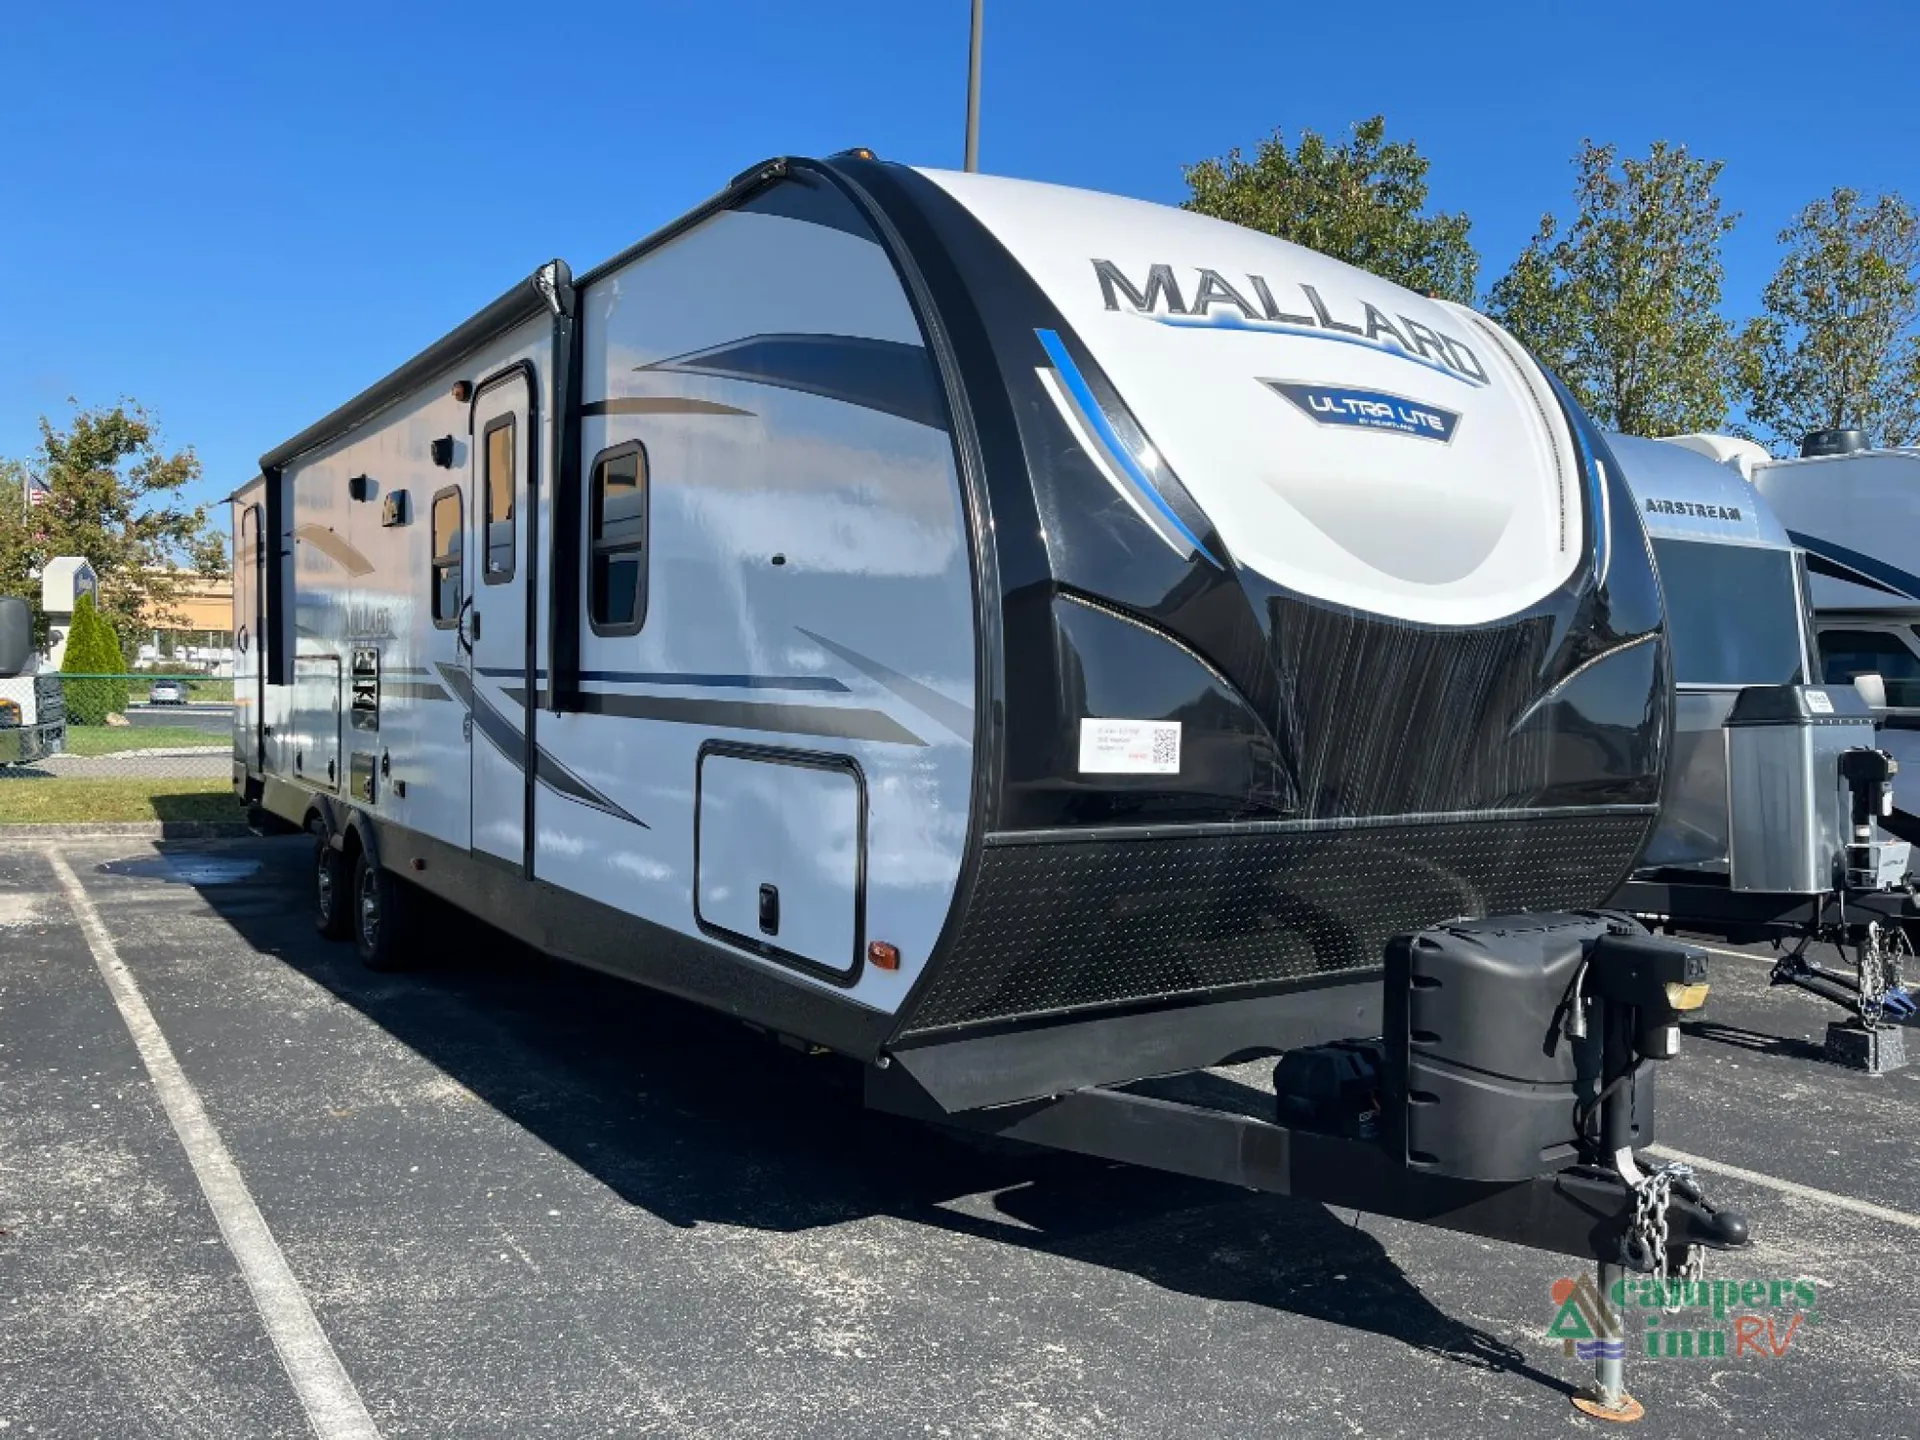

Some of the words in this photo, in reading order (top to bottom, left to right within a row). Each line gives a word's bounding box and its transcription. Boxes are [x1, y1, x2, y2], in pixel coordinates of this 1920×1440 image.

[1090, 258, 1491, 385] MALLARD
[1308, 396, 1394, 419] ULTRA
[1398, 406, 1445, 432] LITE
[1645, 498, 1742, 521] AIRSTREAM
